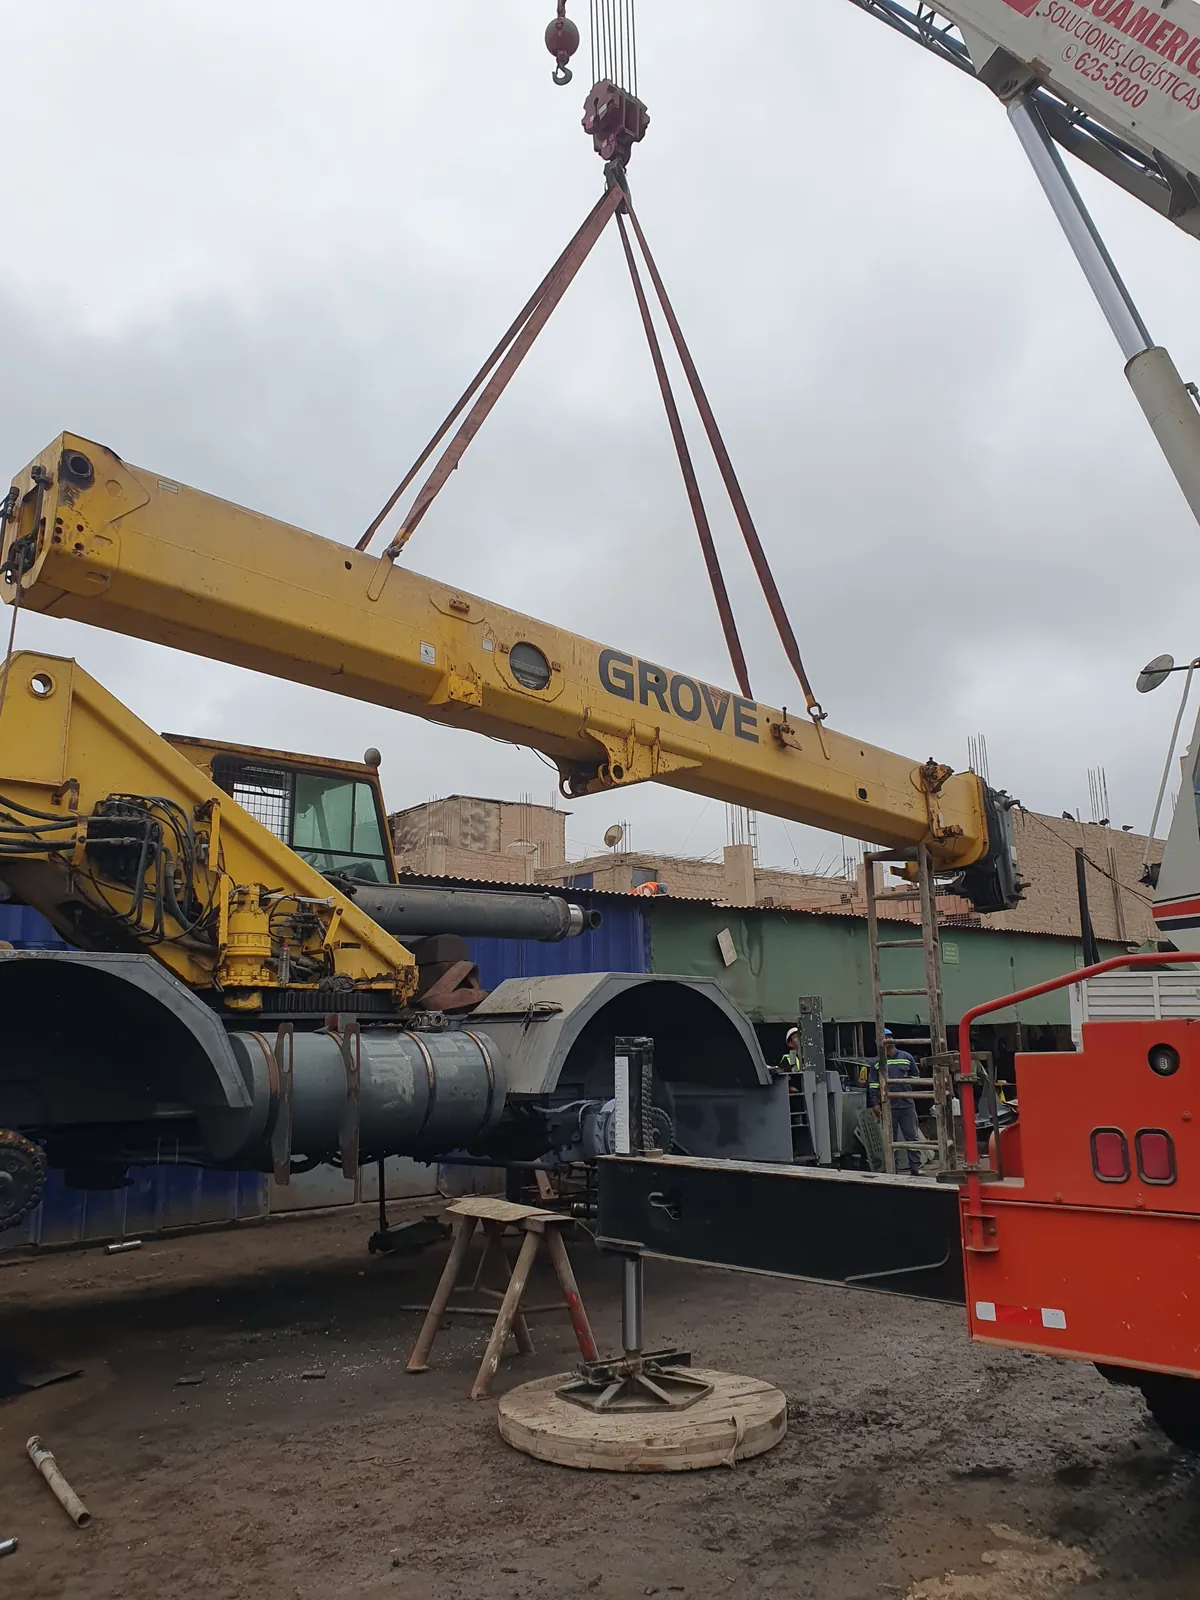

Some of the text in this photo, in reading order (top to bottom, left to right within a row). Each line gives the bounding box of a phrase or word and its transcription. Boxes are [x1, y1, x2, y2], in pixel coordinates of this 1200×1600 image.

[1042, 1, 1126, 60] SOLUCIONES
[1074, 52, 1149, 108] 625-5000
[599, 649, 759, 744] GROVE
